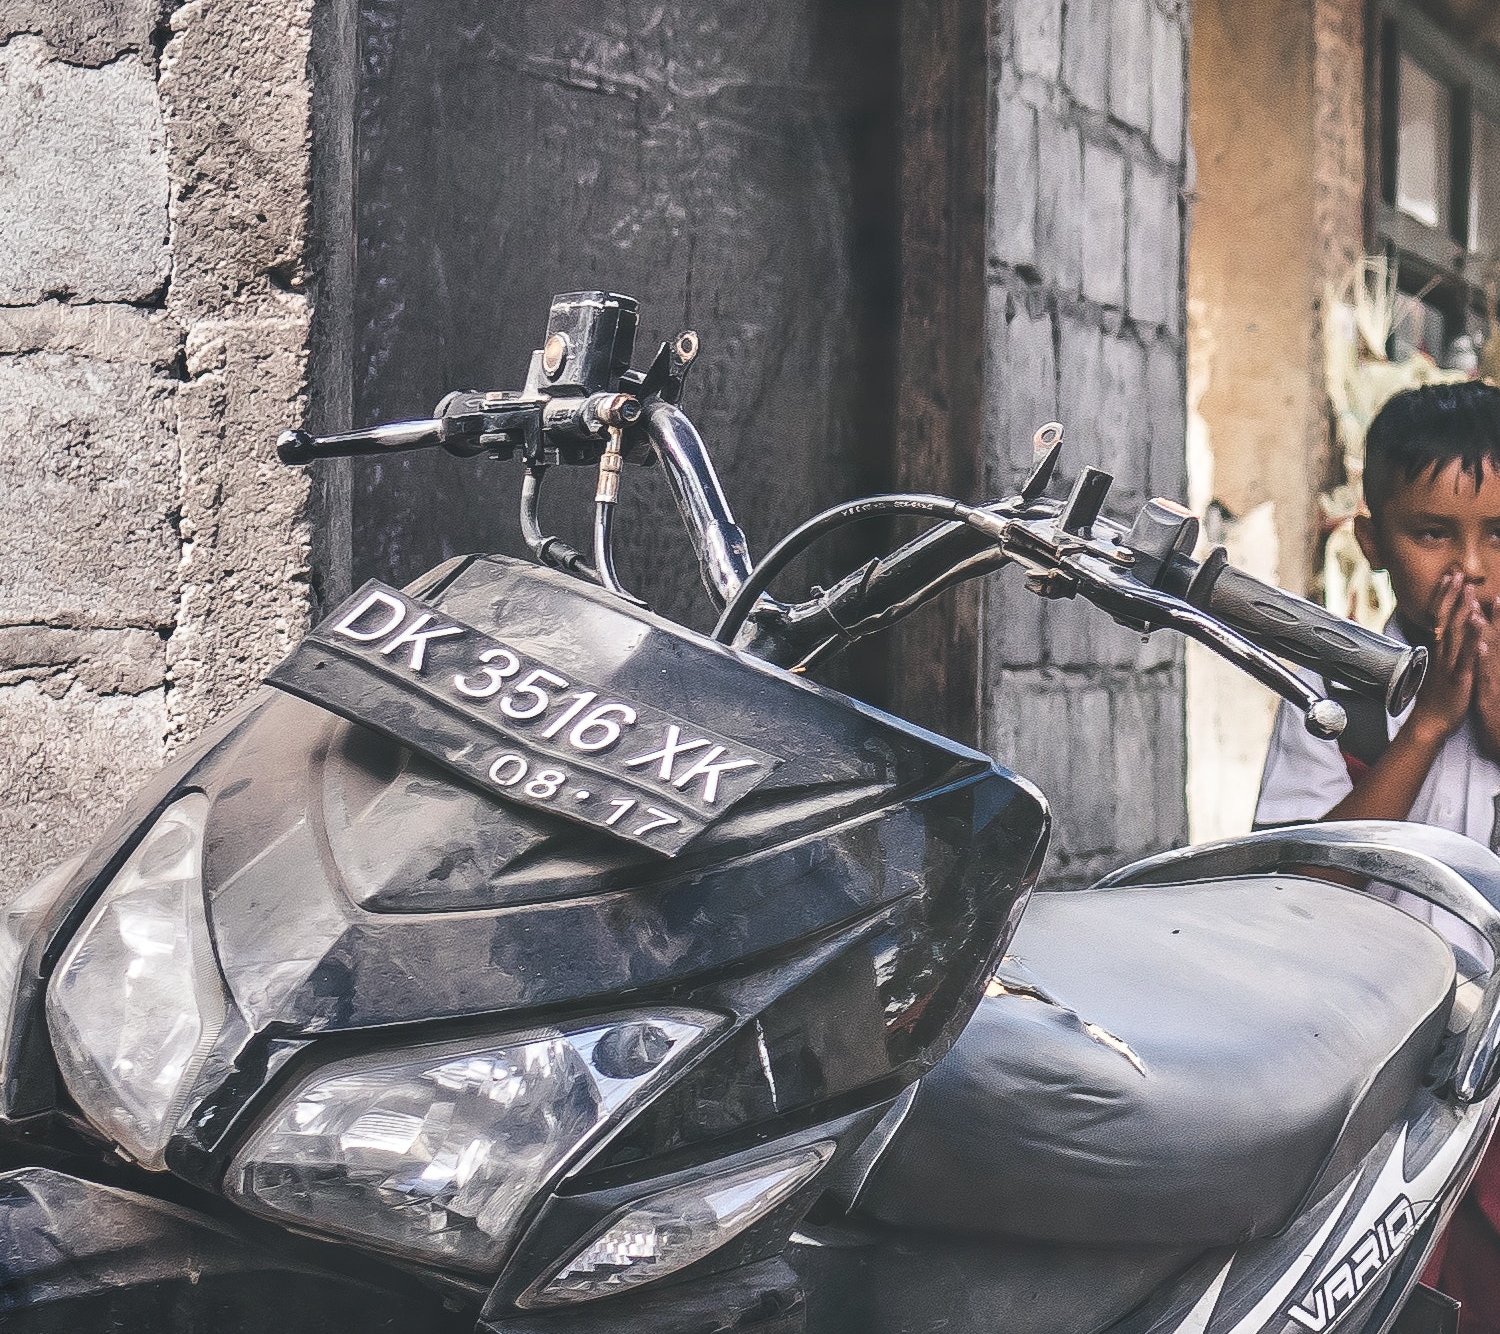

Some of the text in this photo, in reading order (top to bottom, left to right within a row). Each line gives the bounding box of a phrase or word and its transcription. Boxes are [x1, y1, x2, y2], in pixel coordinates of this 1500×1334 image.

[332, 589, 759, 803] DK 3516 XK
[1286, 1195, 1418, 1333] VARIO
